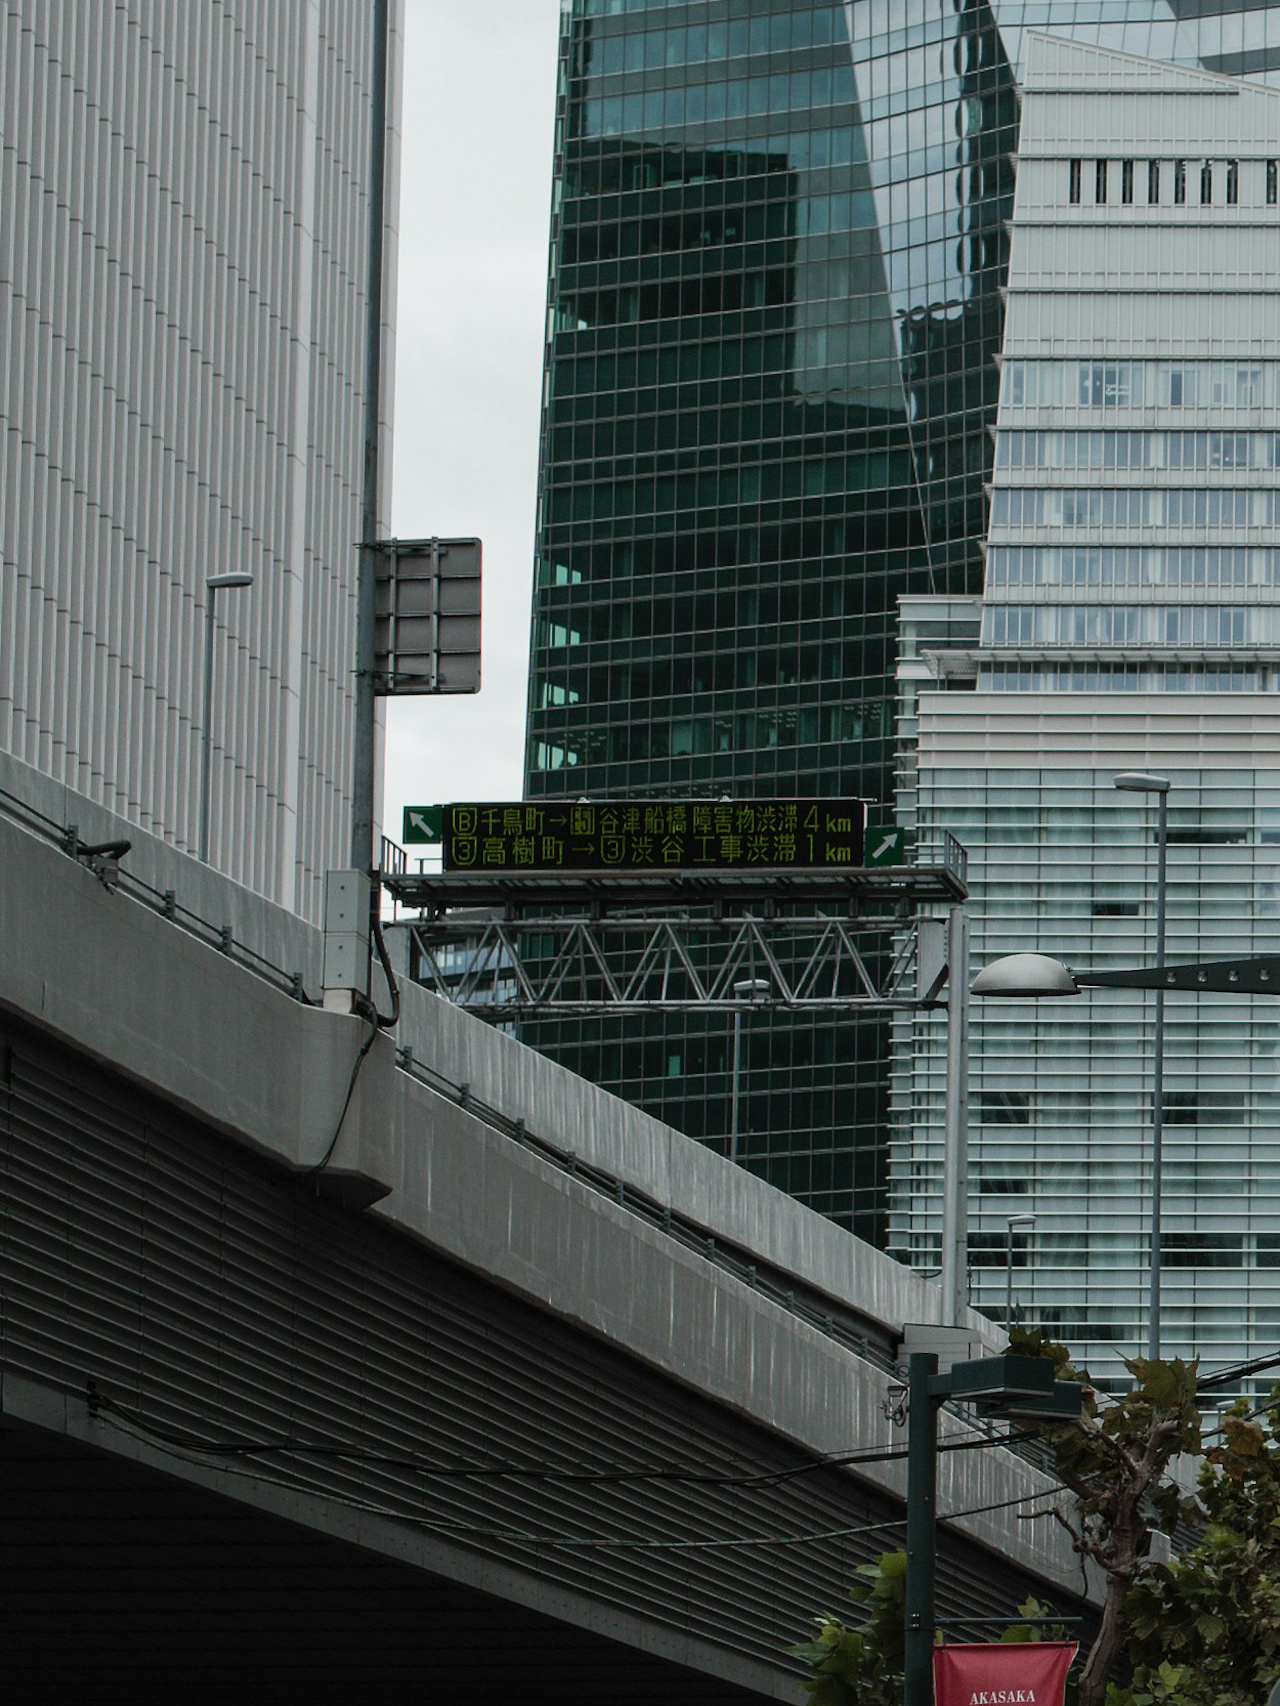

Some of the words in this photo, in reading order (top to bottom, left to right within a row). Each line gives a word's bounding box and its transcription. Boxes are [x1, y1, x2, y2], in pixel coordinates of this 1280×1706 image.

[481, 807, 545, 836] 千鳥町
[600, 806, 687, 834] 谷津船橋
[693, 805, 798, 833] 障害物渋滞
[826, 814, 851, 833] km
[482, 836, 564, 865] 高樹町
[631, 835, 684, 863] 渋谷
[693, 834, 795, 863] 工事渋滞
[825, 843, 851, 862] km
[970, 1689, 1035, 1705] AKASAKA
